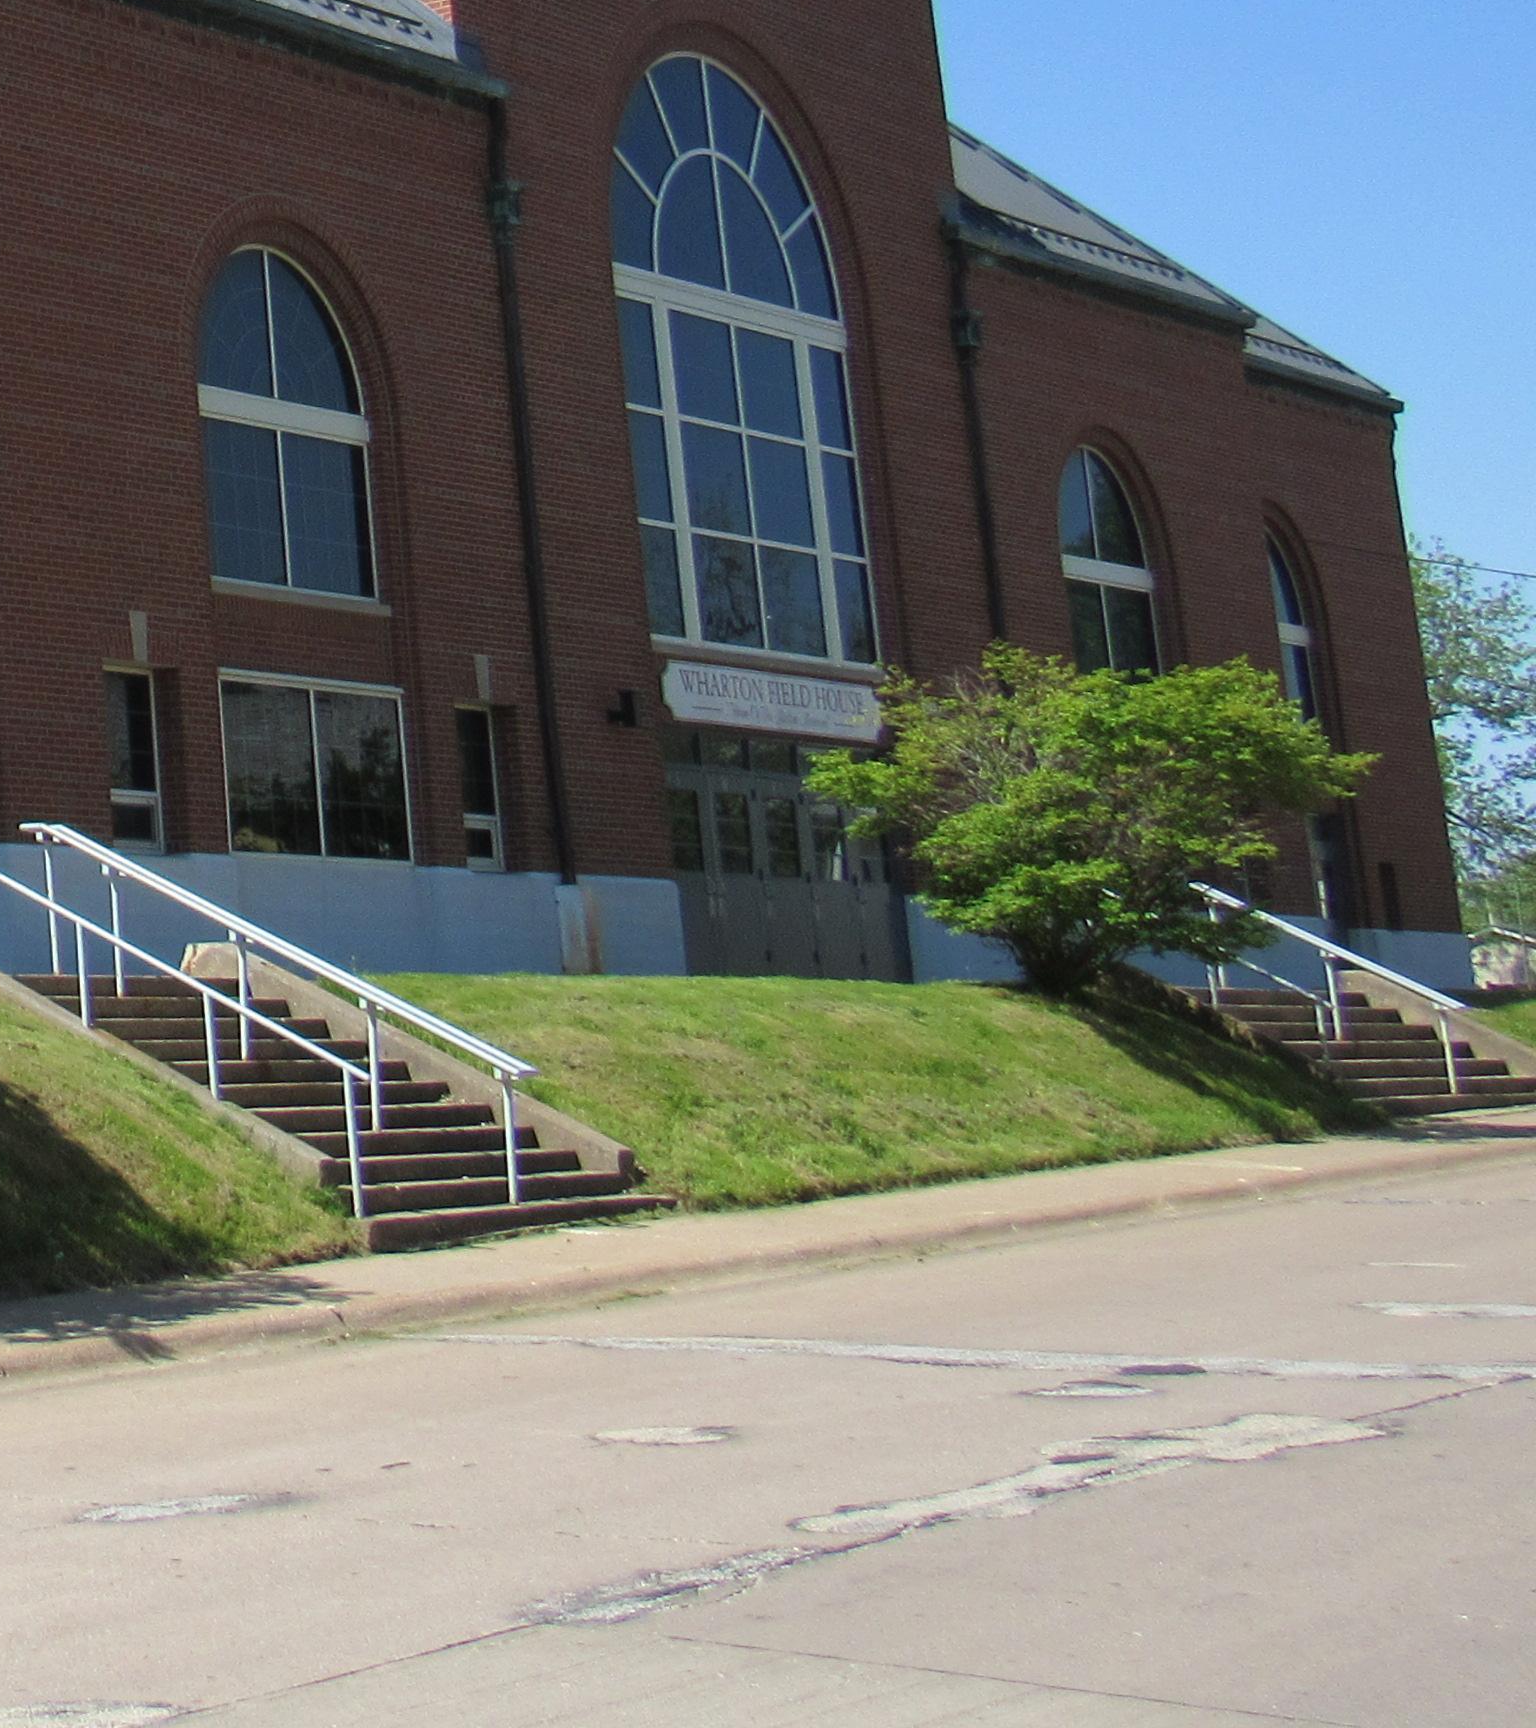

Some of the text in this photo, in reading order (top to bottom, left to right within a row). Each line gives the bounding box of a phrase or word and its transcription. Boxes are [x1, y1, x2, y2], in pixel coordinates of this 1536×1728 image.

[679, 669, 764, 702] WHARTON
[768, 680, 811, 708] FIELD
[815, 687, 866, 715] HOUSE
